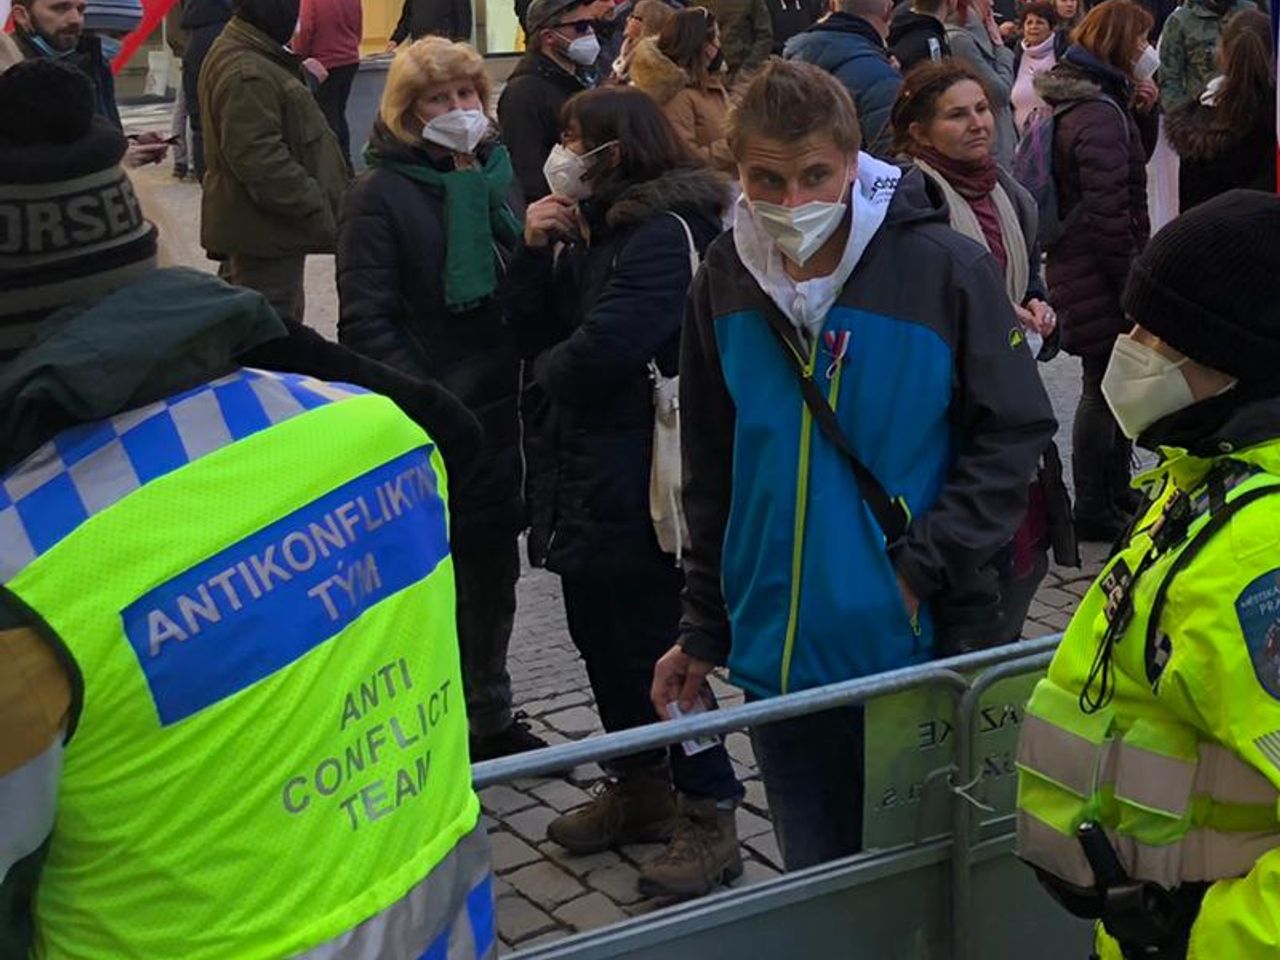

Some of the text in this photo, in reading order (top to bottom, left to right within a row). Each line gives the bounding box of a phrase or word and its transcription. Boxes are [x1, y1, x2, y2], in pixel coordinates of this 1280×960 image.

[308, 553, 382, 622] TÝM
[340, 657, 413, 730] ANTI
[281, 680, 452, 814] CONFLICT
[338, 750, 432, 831] TEAM
